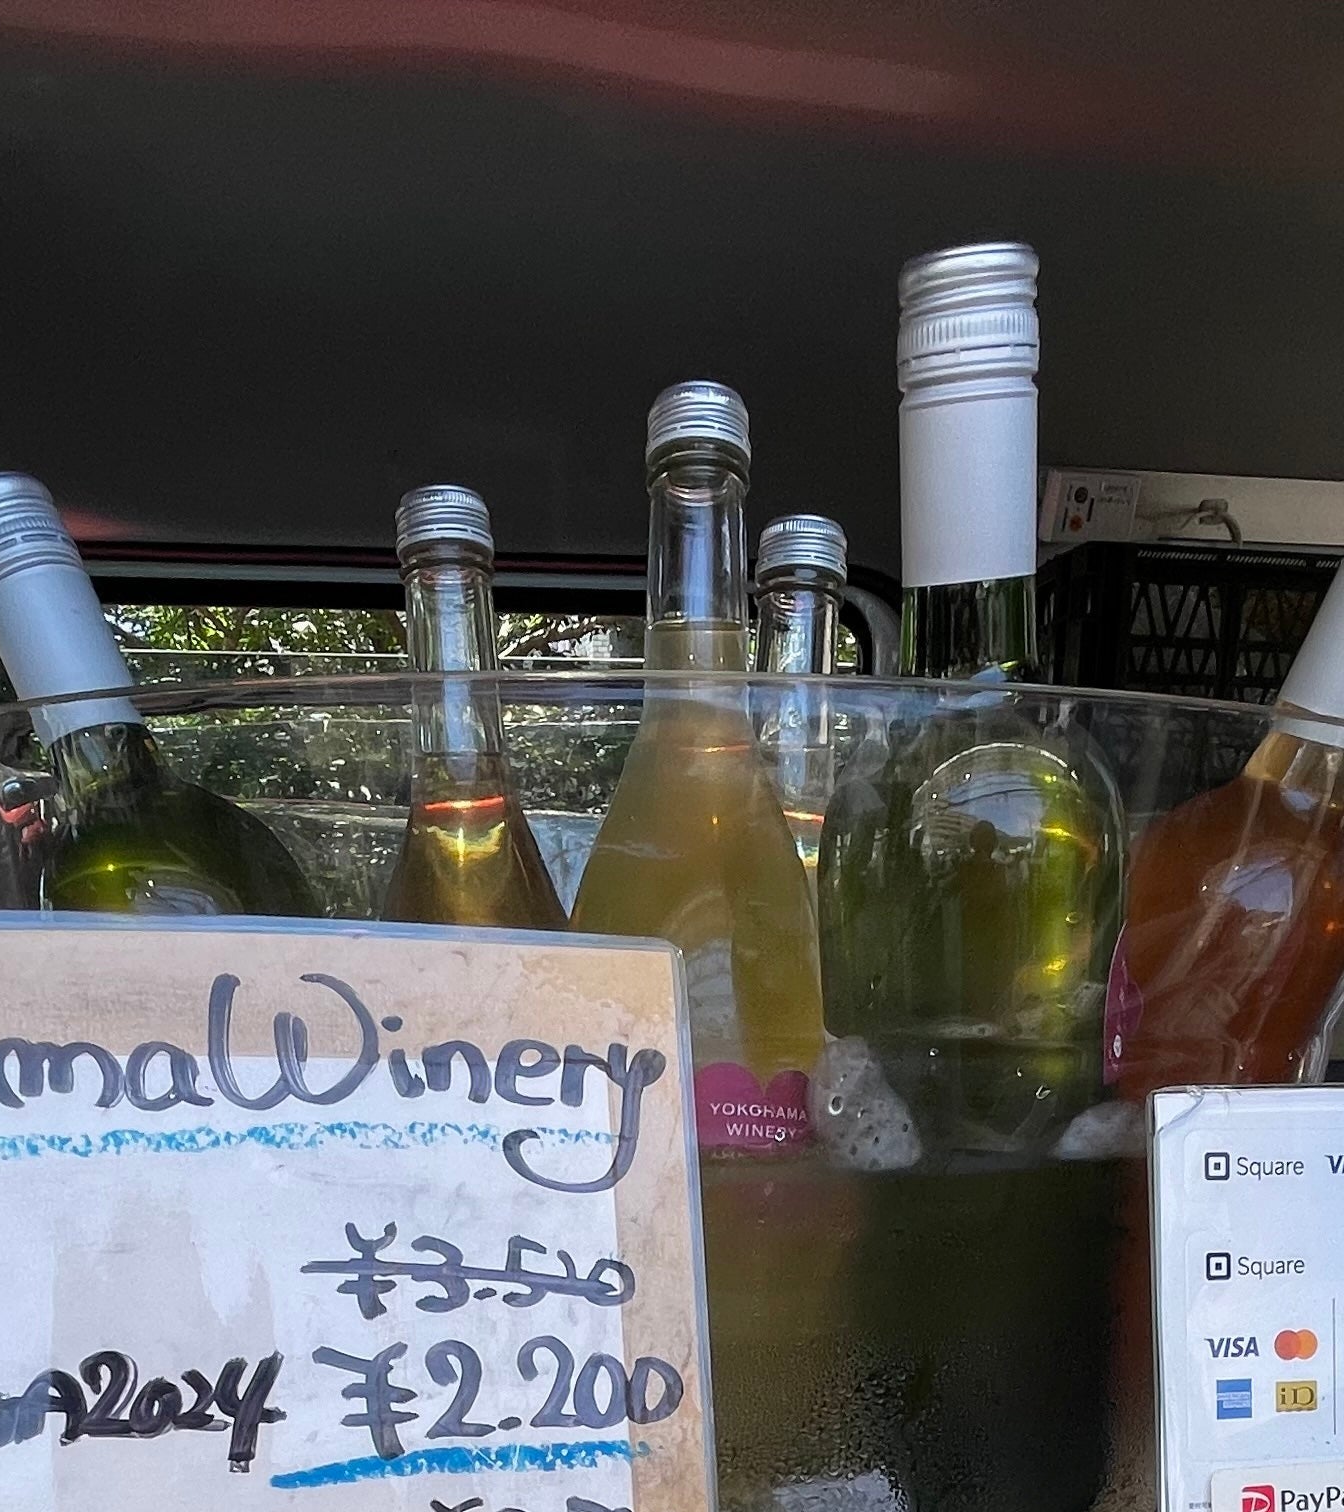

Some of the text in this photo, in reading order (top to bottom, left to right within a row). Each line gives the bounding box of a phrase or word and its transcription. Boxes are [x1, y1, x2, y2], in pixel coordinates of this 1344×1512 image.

[710, 1102, 808, 1122] YOKOHAMA
[1237, 1156, 1305, 1181] Square
[1237, 1255, 1305, 1280] Square
[1204, 1337, 1260, 1359] VISA
[312, 1335, 684, 1460] ¥2.200
[1280, 1387, 1315, 1406] iD
